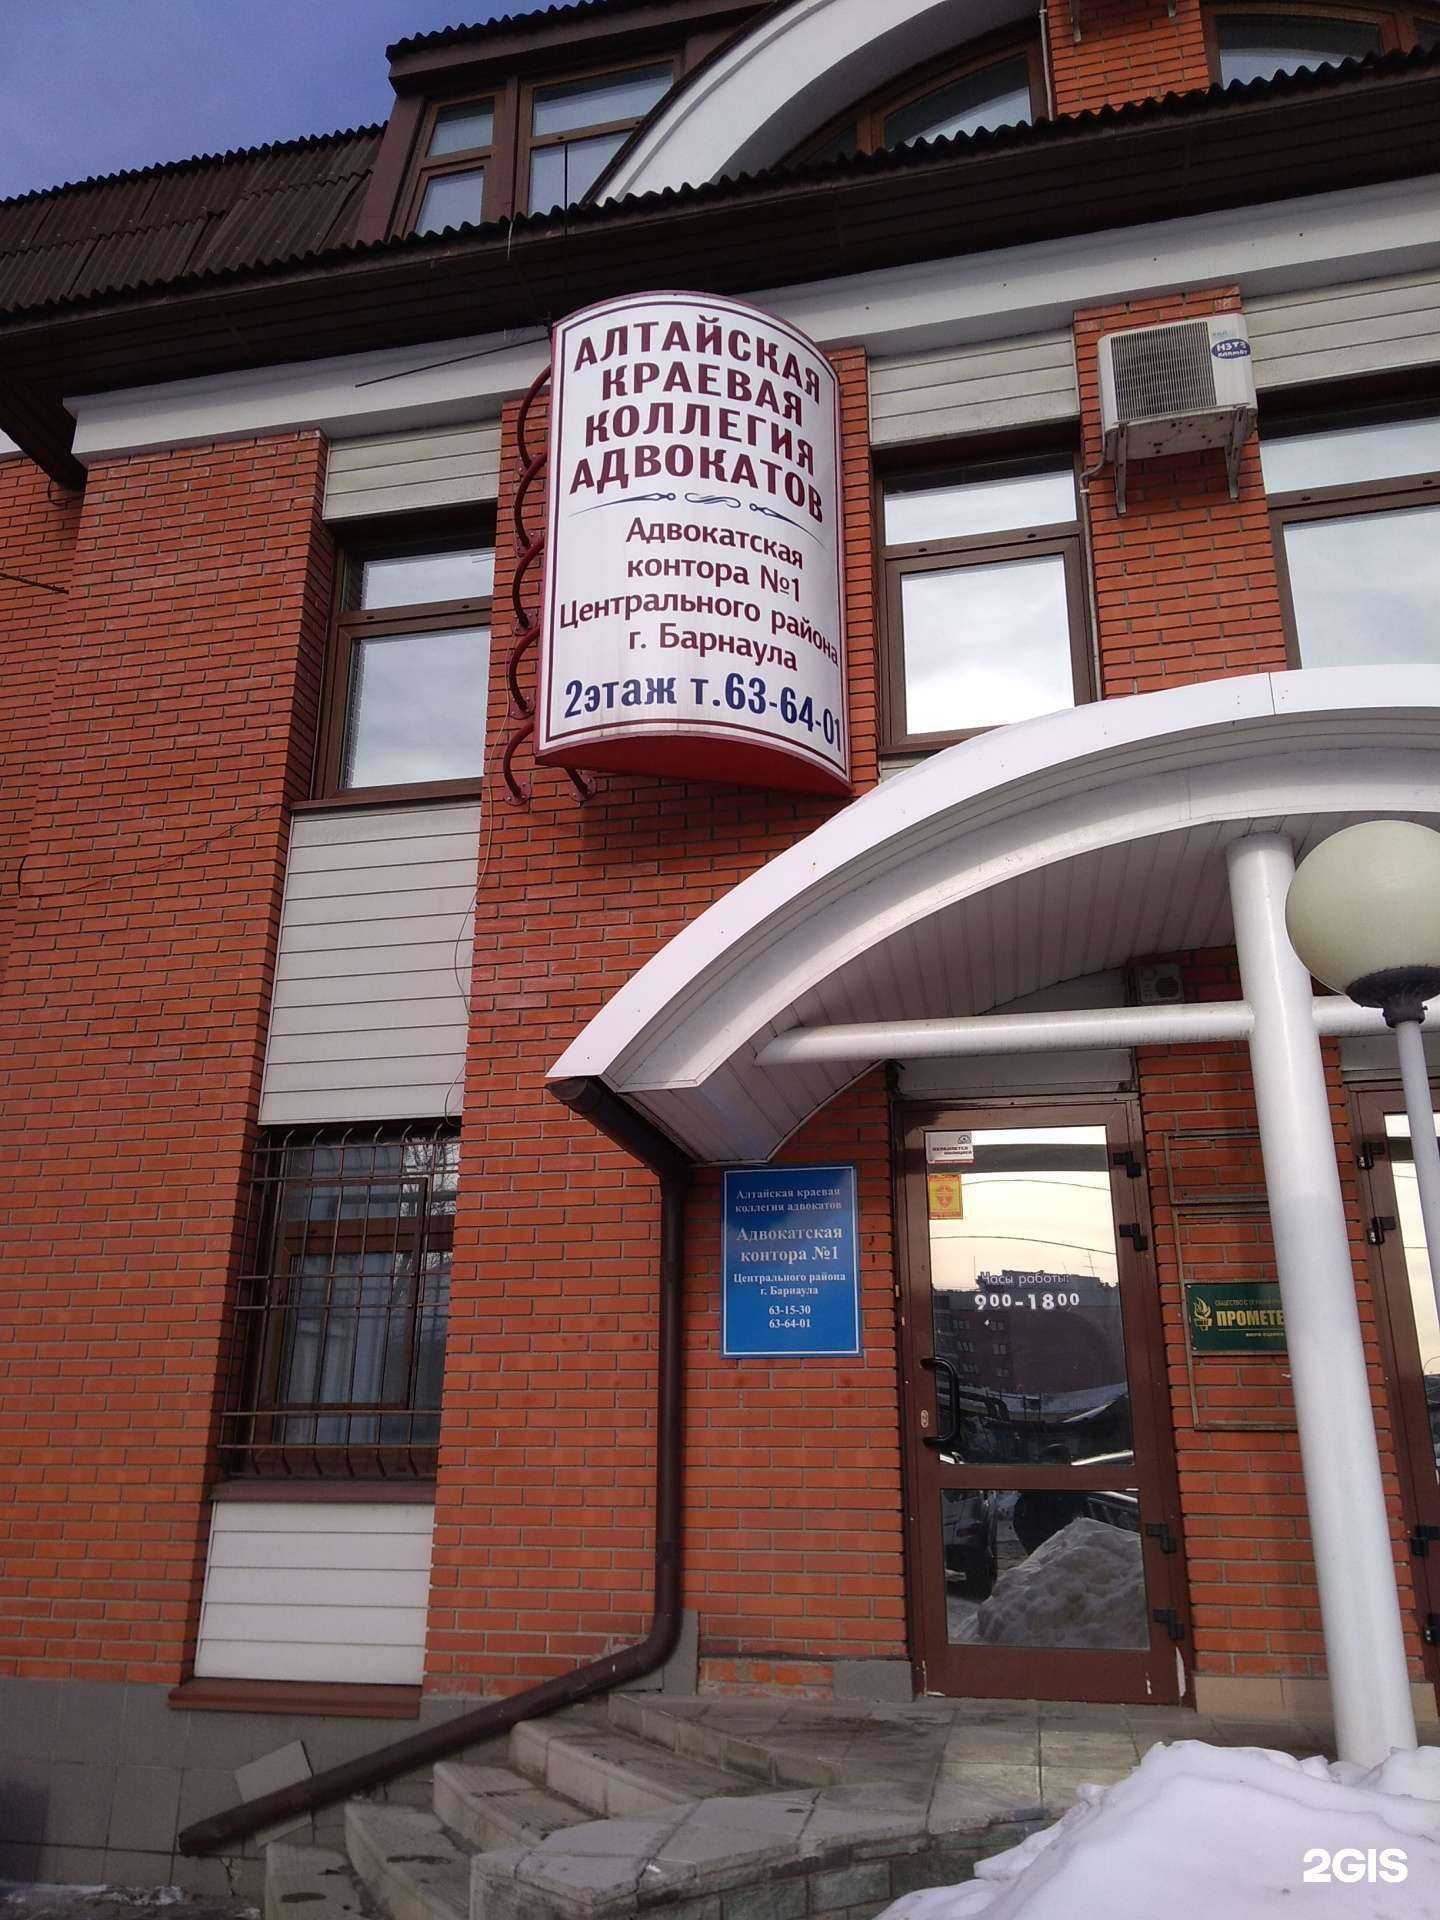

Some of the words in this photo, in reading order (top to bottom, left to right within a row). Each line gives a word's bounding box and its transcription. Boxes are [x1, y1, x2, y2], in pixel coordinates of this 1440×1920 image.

[573, 314, 820, 404] АЛТАЙСКАЯ
[602, 361, 802, 427] КРАЕВАЯ
[585, 402, 814, 476] КОЛЛЕГИЯ
[569, 444, 823, 523] АДВОКАТОВ
[626, 517, 803, 569] Адвокатская
[627, 558, 750, 587] контора
[760, 565, 800, 602] №1
[560, 593, 760, 628] Центрального
[771, 610, 839, 667] района
[629, 631, 647, 650] г.
[659, 623, 798, 671] Барнаула
[564, 677, 677, 718] 2этаж
[735, 1203, 784, 1213] коллегия
[787, 1201, 842, 1212] адвокатов
[736, 1189, 794, 1200] Алтайская
[797, 1188, 840, 1199] краевая
[736, 1227, 843, 1241] Адвокатская
[741, 1250, 807, 1264] контора
[811, 1246, 839, 1260] №1
[733, 1273, 807, 1284] Центрального
[809, 1272, 846, 1285] района
[760, 1287, 767, 1295] г.
[770, 1285, 819, 1297] Барнаула
[981, 1273, 1013, 1285] Часы
[768, 1304, 811, 1315] 63-15-30
[768, 1318, 811, 1328] 63-64-01
